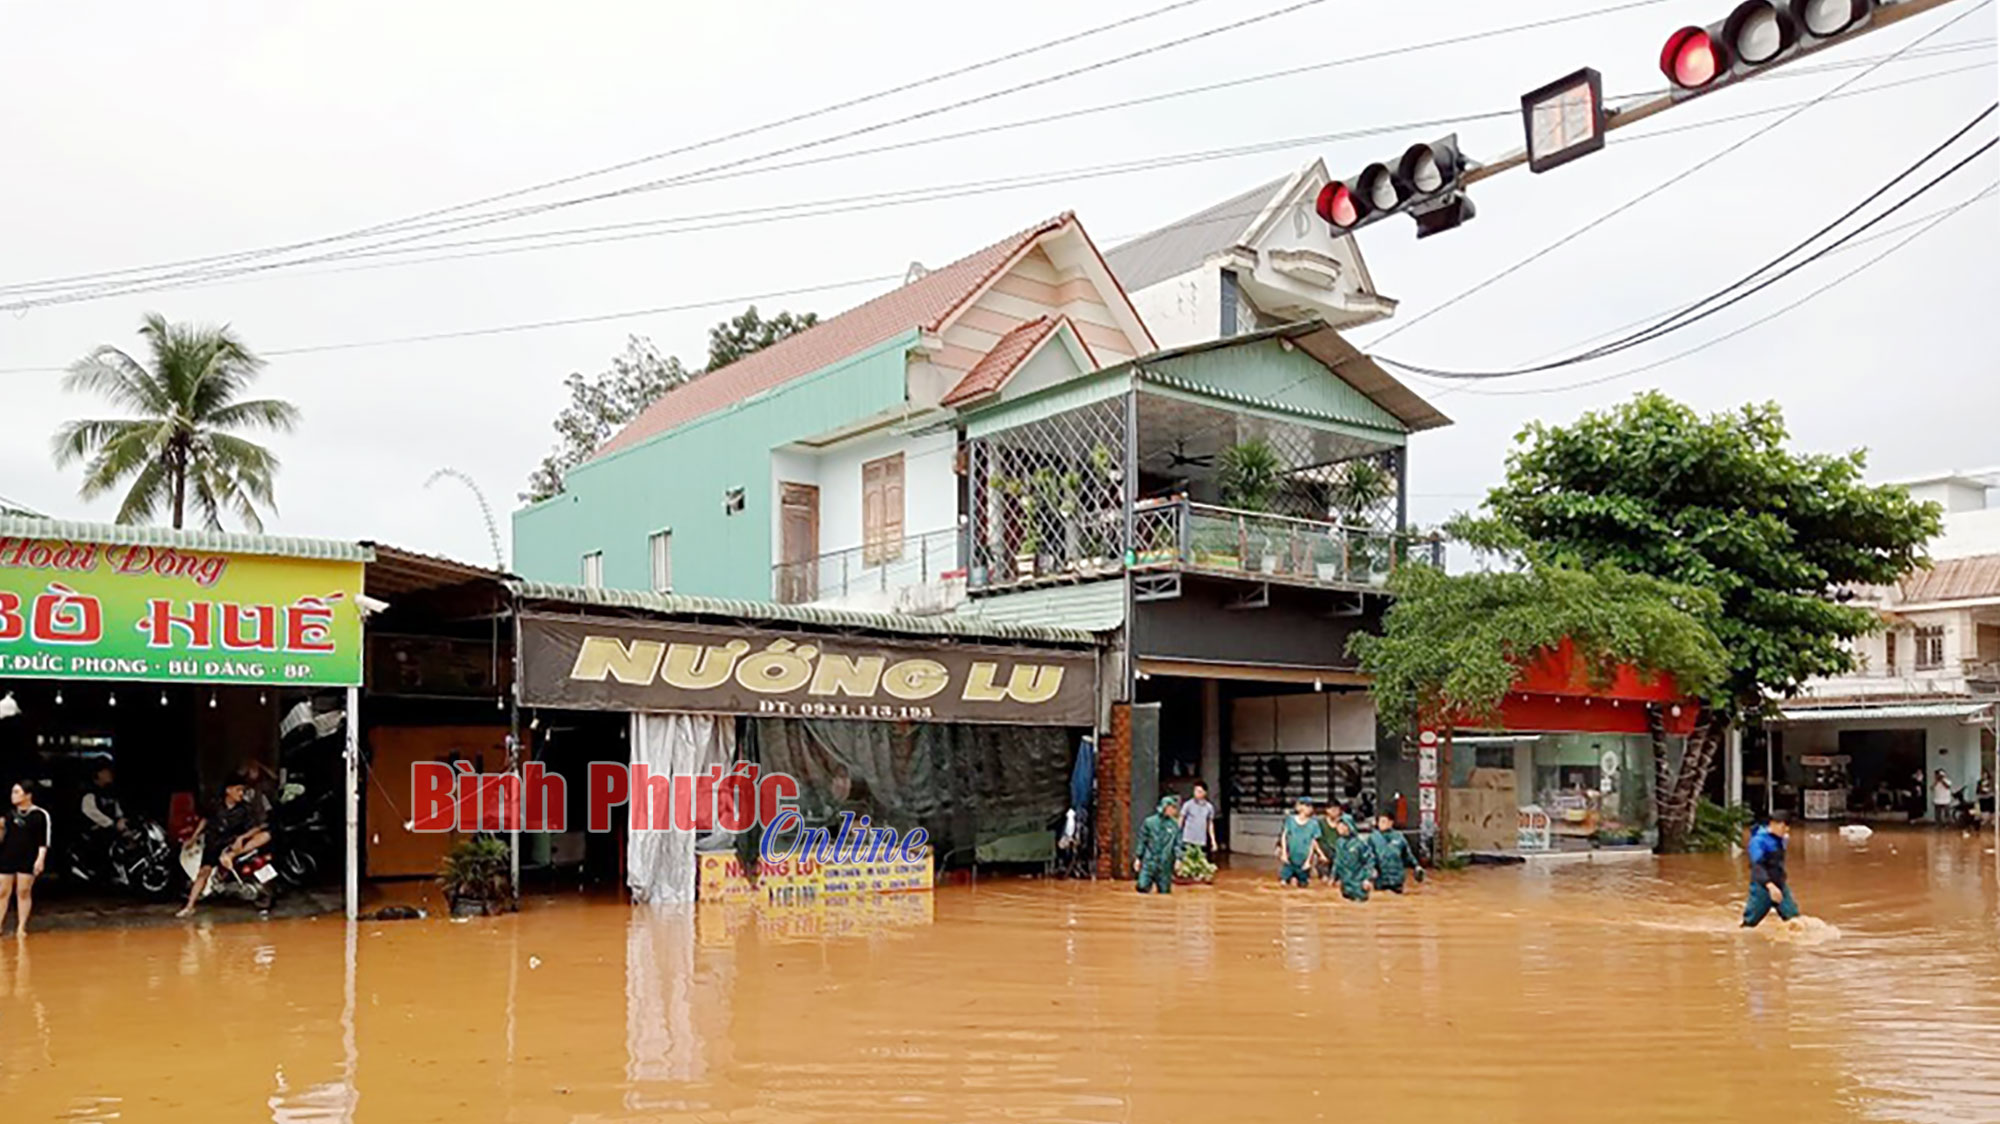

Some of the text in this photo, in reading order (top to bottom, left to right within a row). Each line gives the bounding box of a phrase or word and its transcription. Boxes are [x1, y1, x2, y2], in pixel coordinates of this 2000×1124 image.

[0, 581, 345, 653] BÒ HUẾ
[71, 656, 148, 674] PHONG
[570, 635, 1064, 704] NƯỚNG LU
